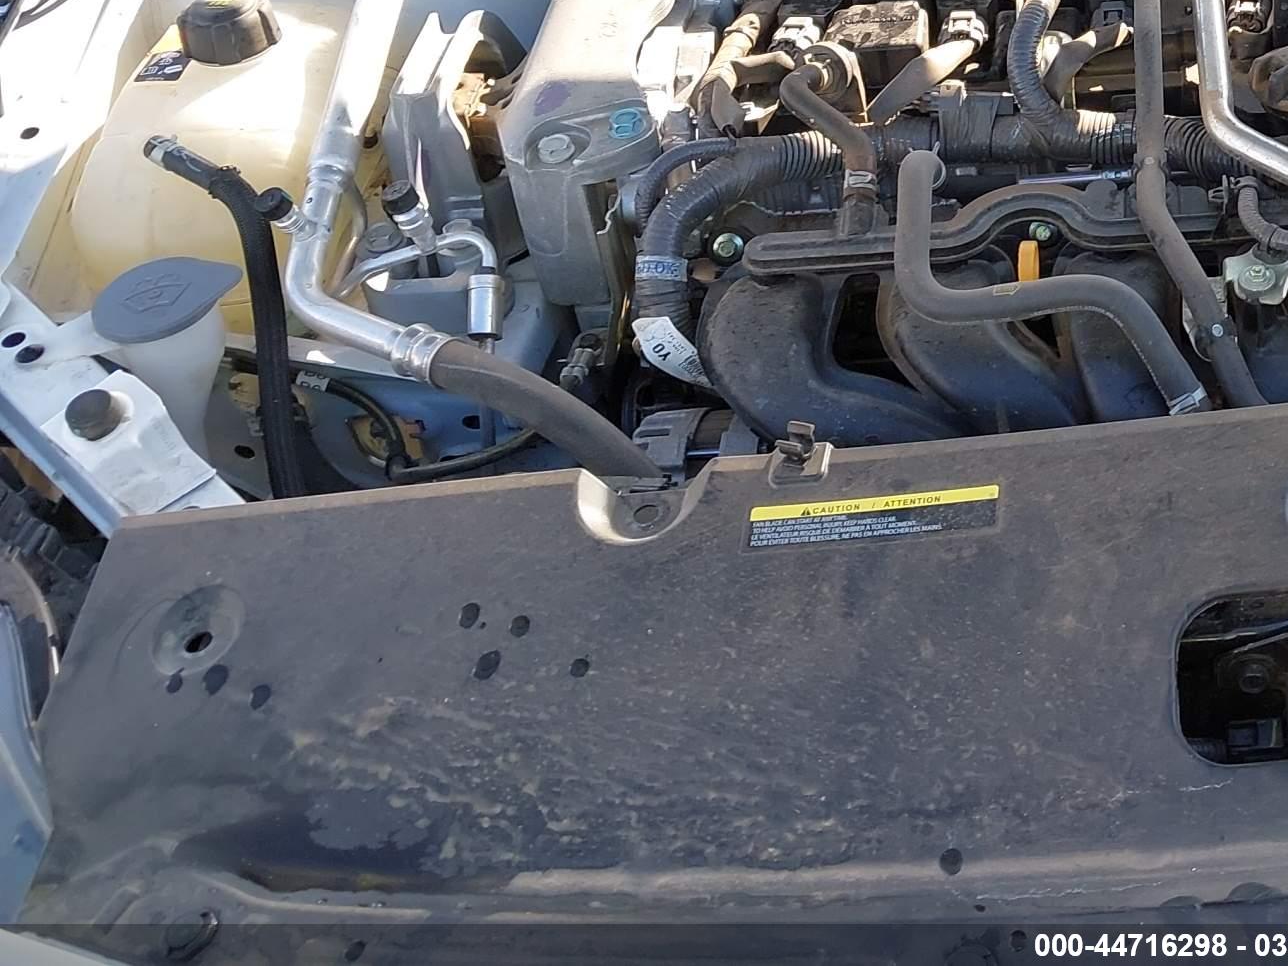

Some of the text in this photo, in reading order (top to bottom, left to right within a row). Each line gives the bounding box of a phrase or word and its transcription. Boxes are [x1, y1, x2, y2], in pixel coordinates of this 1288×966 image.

[812, 503, 861, 515] CAUTION
[883, 495, 942, 509] ATTENTION
[750, 539, 768, 547] POUR
